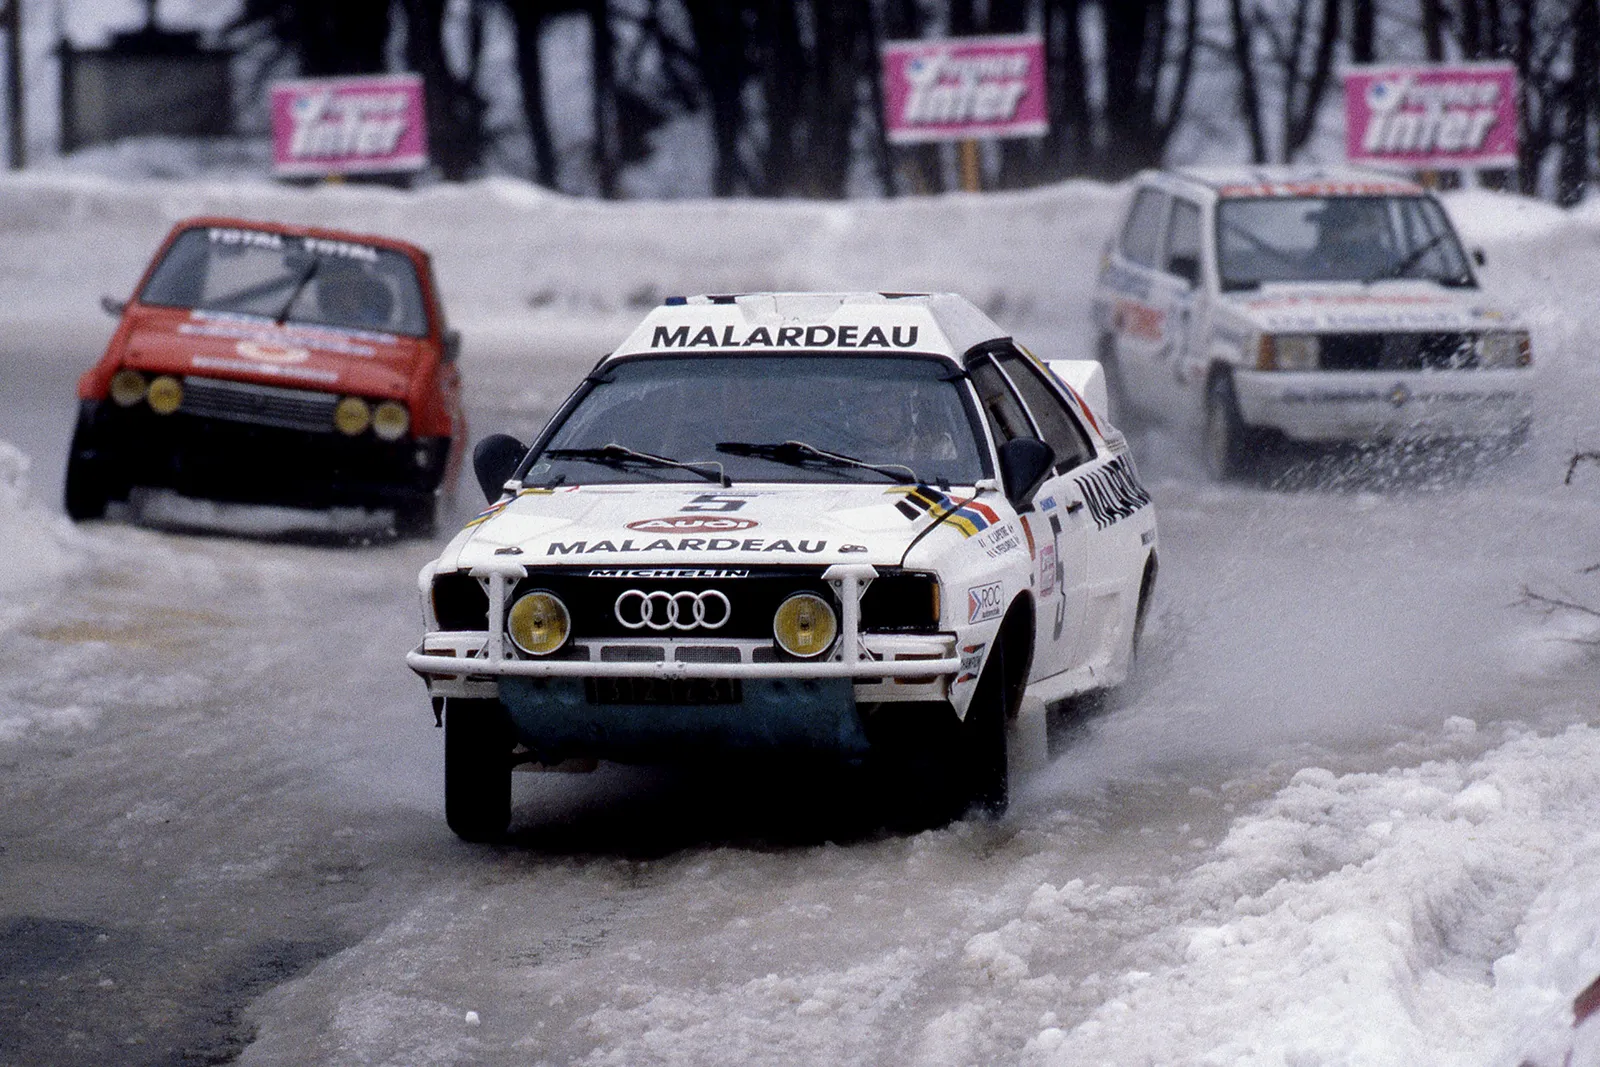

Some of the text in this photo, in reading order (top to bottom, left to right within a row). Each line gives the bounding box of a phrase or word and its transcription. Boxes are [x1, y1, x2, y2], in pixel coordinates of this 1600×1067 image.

[208, 228, 379, 262] TOTAL TOTAL
[651, 325, 918, 348] MALARDEAU
[679, 494, 759, 511] 5
[547, 538, 827, 555] MALARDEAU
[589, 568, 749, 578] MICHELIN
[982, 585, 1001, 608] ROC
